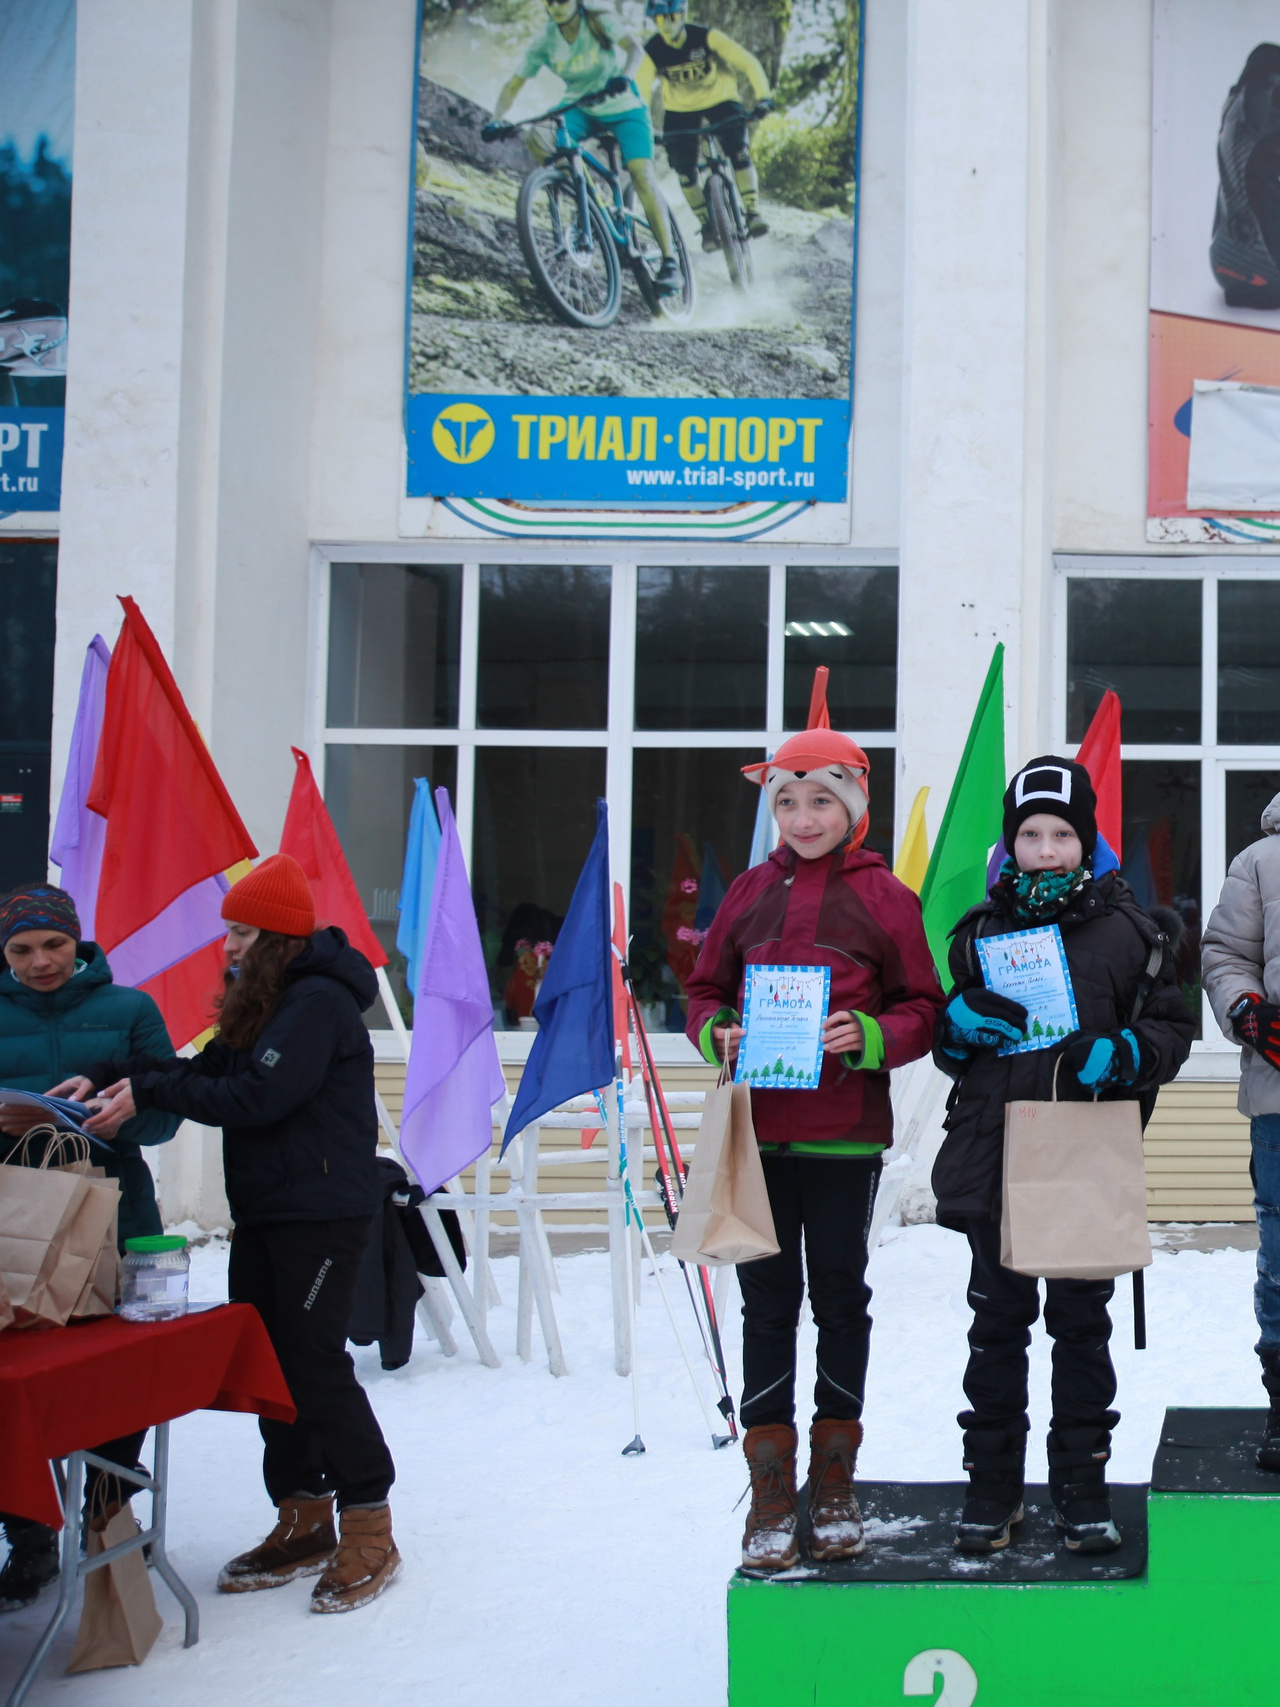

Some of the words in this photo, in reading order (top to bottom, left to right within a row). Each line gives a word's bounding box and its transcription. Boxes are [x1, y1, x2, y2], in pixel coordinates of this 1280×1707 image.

[627, 466, 815, 490] www.trial-sport.ru
[998, 958, 1052, 976] ГРАМОТА
[759, 998, 813, 1009] ГРАМОТА
[664, 1174, 678, 1213] NORDWAY
[304, 1258, 333, 1311] noname
